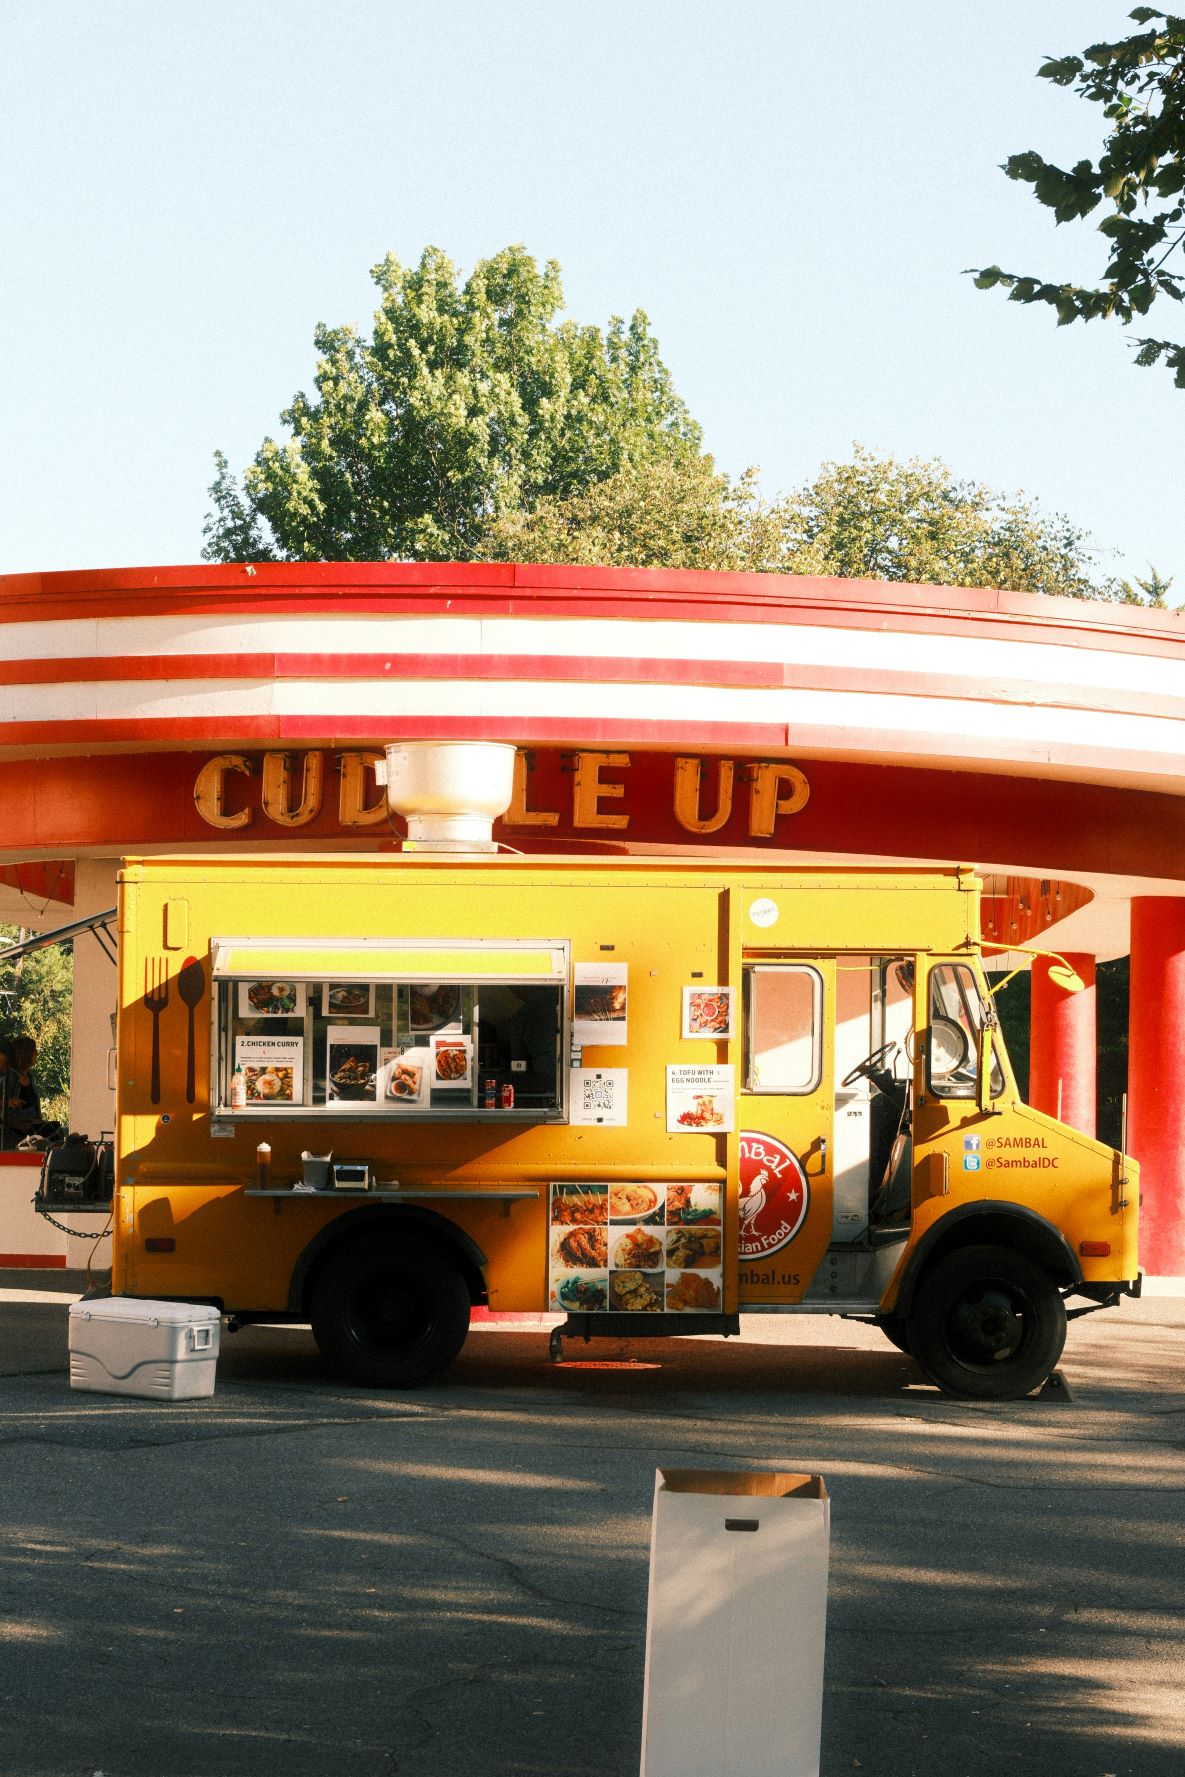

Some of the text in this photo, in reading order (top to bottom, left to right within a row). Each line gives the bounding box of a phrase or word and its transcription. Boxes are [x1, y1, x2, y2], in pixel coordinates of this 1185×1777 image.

[193, 751, 632, 830] CUDLE
[674, 757, 810, 838] UP
[985, 1136, 1048, 1150] @SAMBAL
[985, 1156, 1059, 1170] @SambalDC
[760, 1220, 792, 1249] Food
